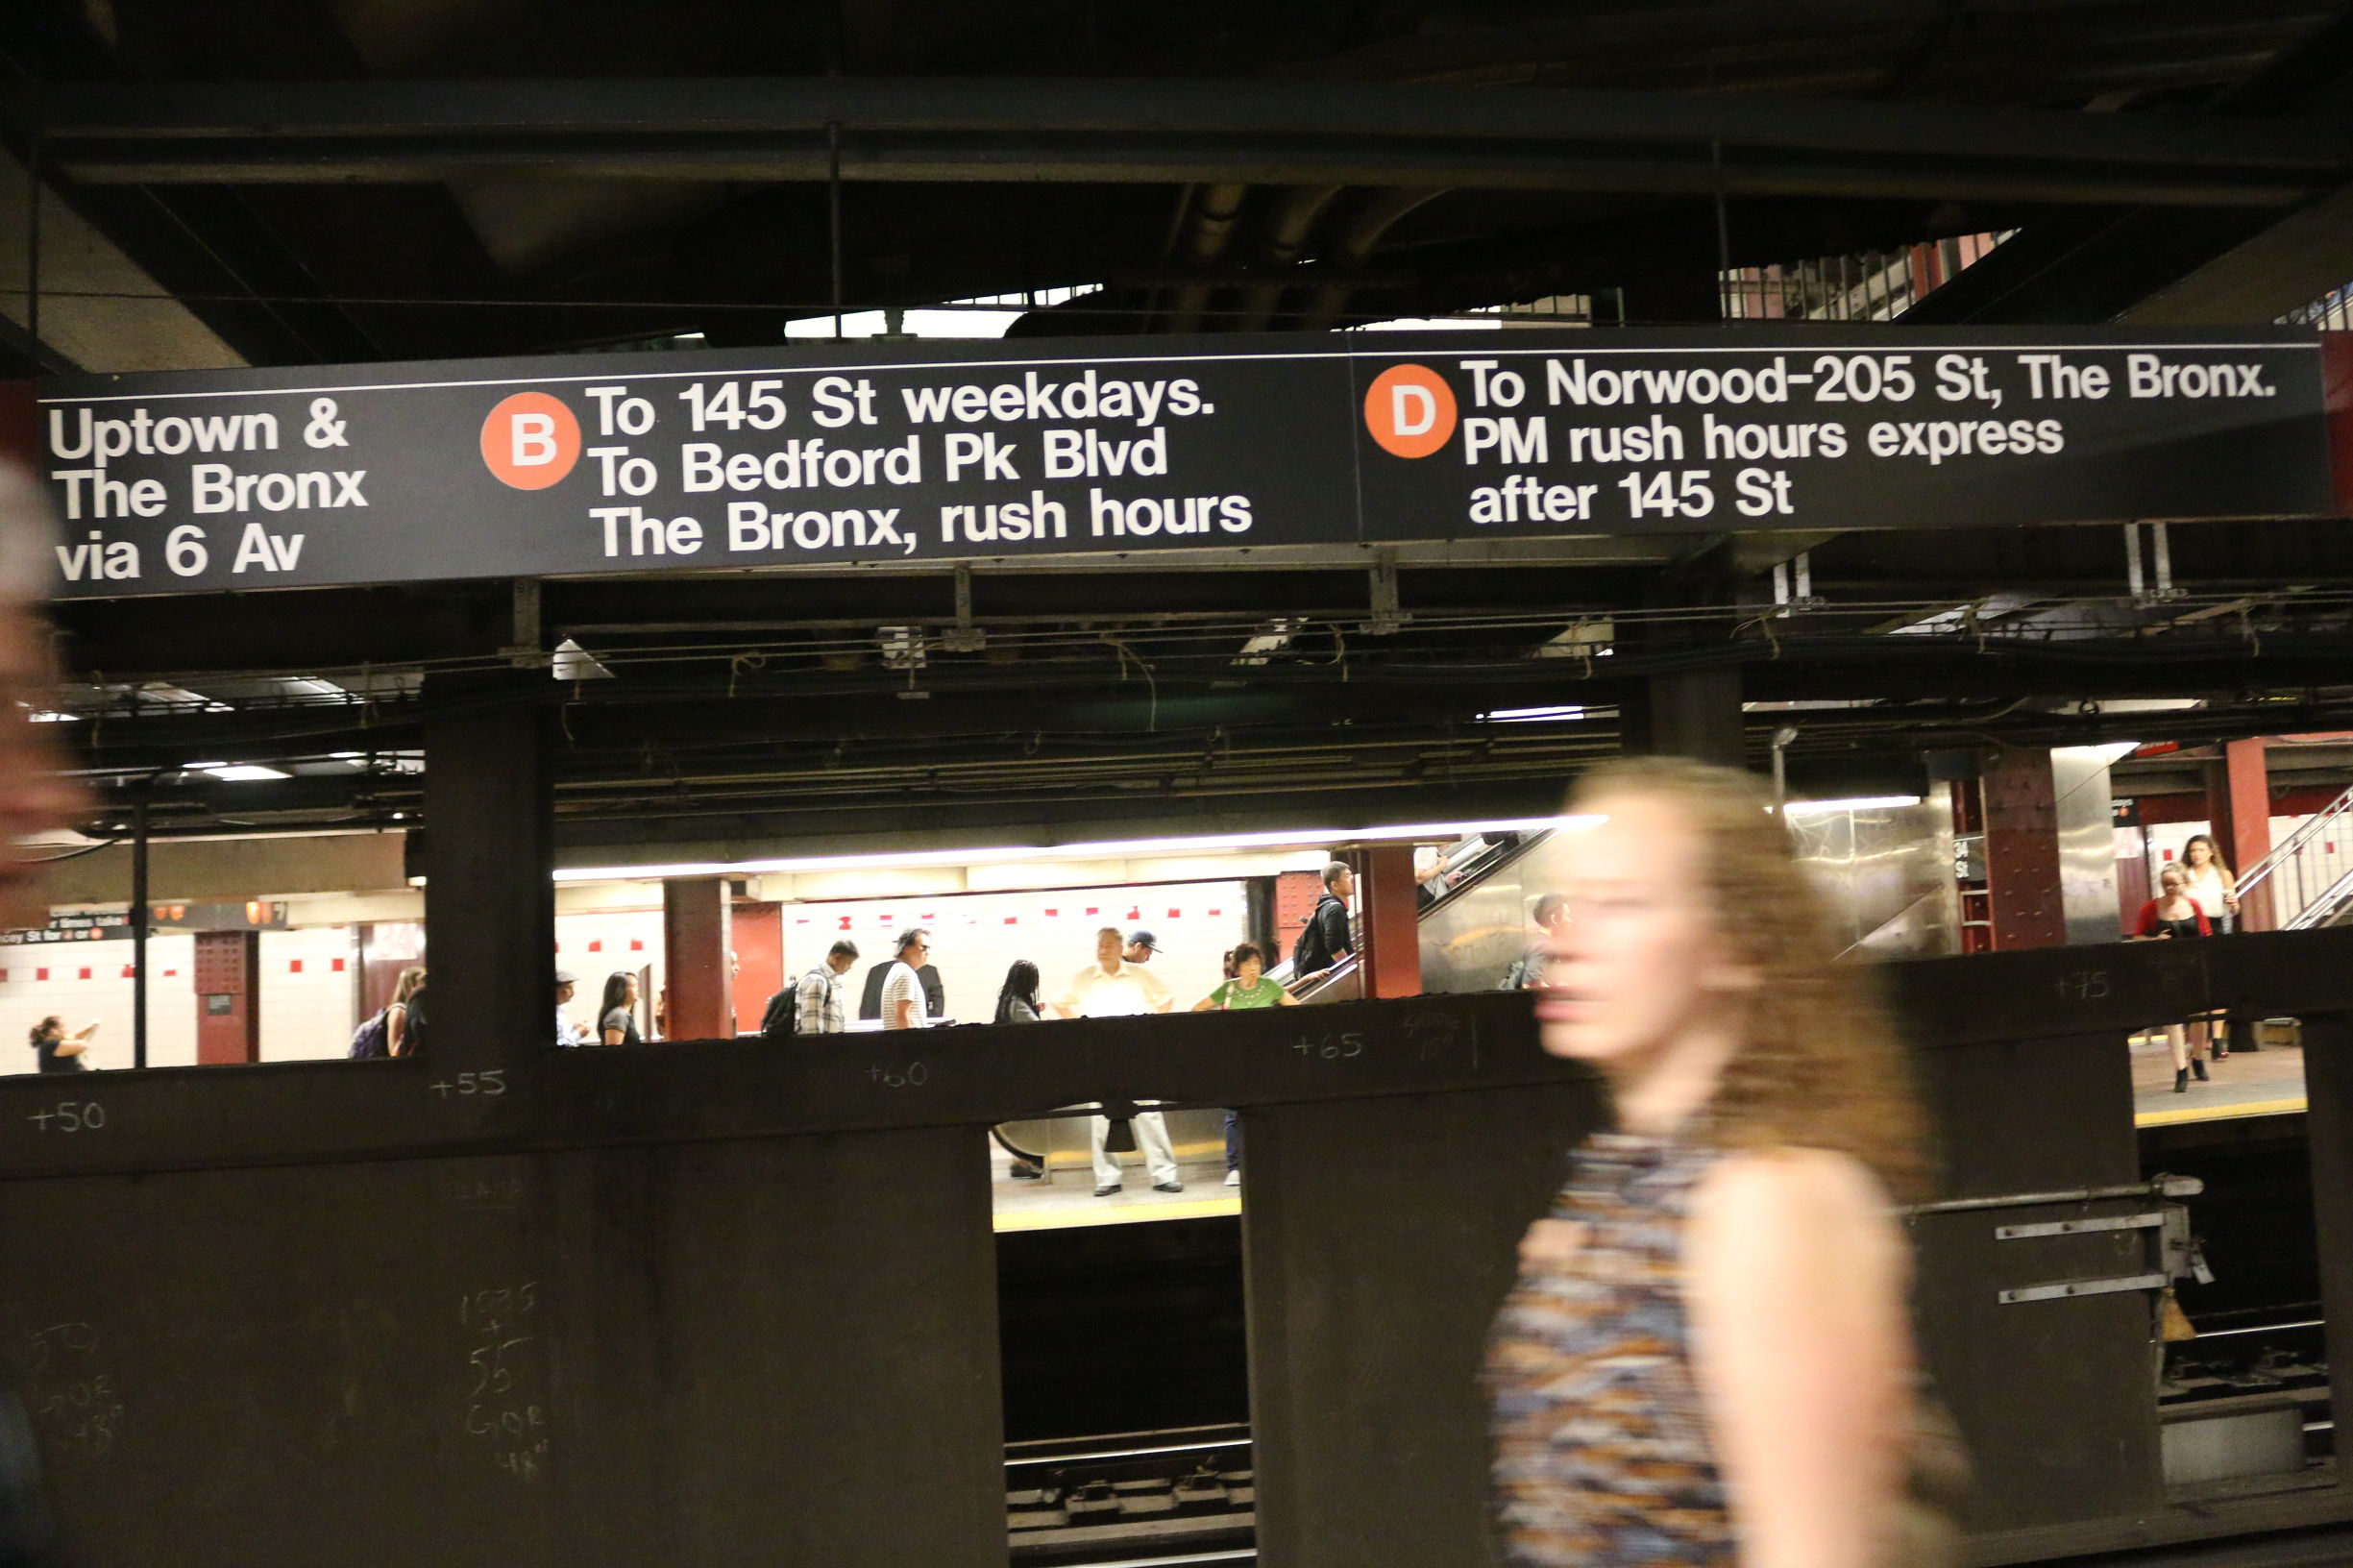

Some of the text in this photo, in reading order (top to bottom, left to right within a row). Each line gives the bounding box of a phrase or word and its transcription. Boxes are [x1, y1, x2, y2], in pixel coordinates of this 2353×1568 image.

[583, 369, 1215, 437] To 145 St weekdays.
[1390, 383, 1437, 437] D
[1458, 353, 2276, 410] To Norwood-205 St, The Bronx.
[50, 396, 351, 469] Uptown &
[509, 411, 560, 469] B
[585, 425, 1168, 498] To Bedford Pk Blvd
[1462, 412, 2065, 467] PM rush hours express
[51, 462, 371, 521] The Bronx
[1468, 466, 1795, 525] after 145 St
[587, 486, 1254, 558] The Bronx, rush hours
[55, 521, 306, 582] via 6 Av
[1292, 1032, 1364, 1060] +65
[429, 1068, 506, 1099] +55
[26, 1101, 105, 1133] +50
